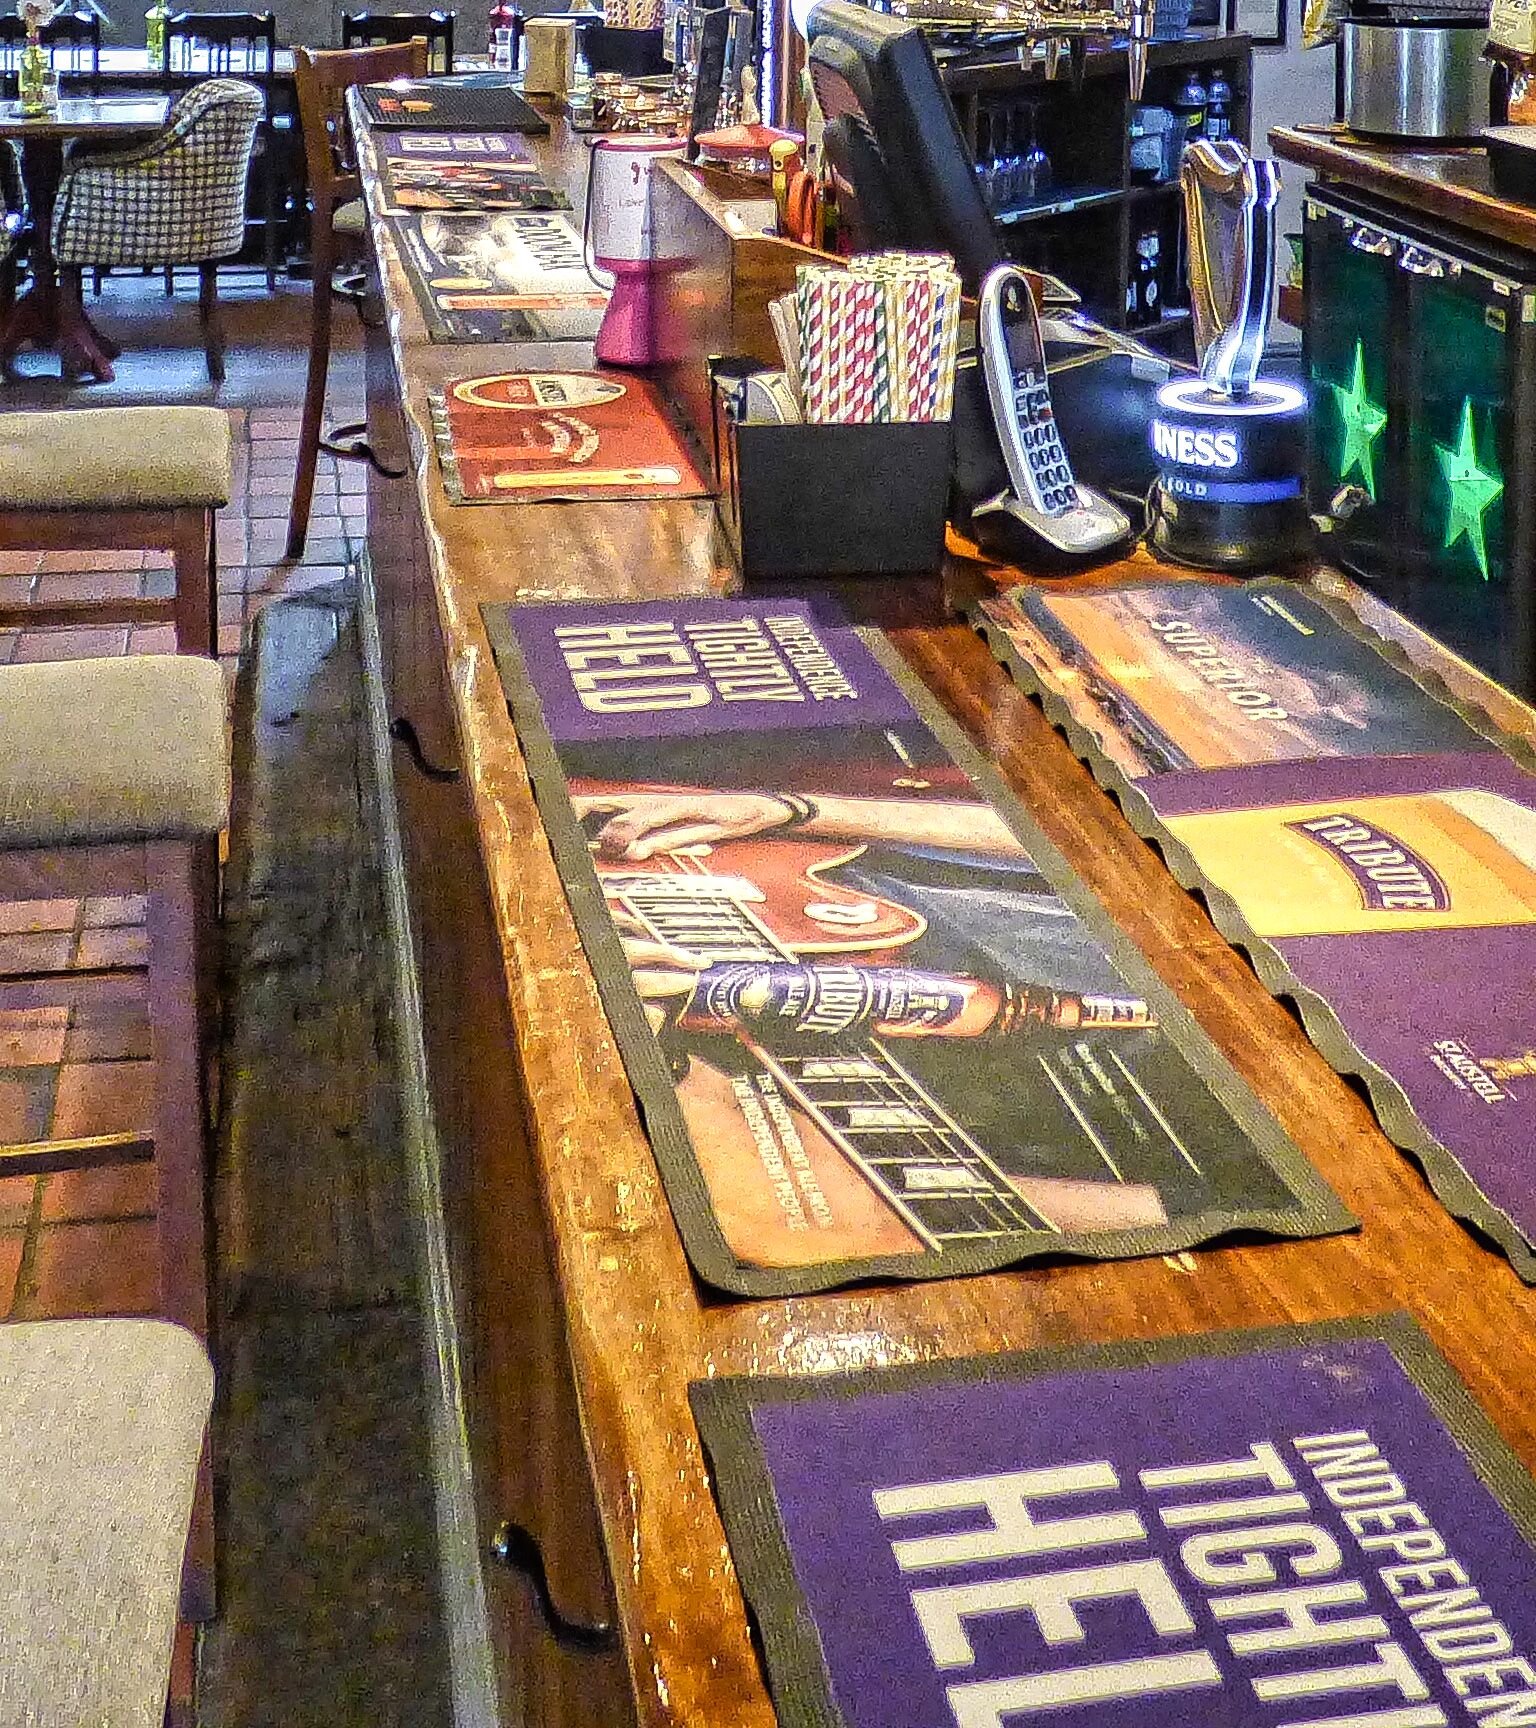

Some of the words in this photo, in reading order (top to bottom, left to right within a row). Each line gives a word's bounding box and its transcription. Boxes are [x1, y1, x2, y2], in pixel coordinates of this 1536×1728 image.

[553, 625, 713, 713] HELD
[683, 621, 805, 705] TIGHTLY
[763, 617, 859, 701] INDEPENDENCE
[1150, 619, 1288, 723] SUPERIOR
[1297, 817, 1442, 912] TRIBUTE
